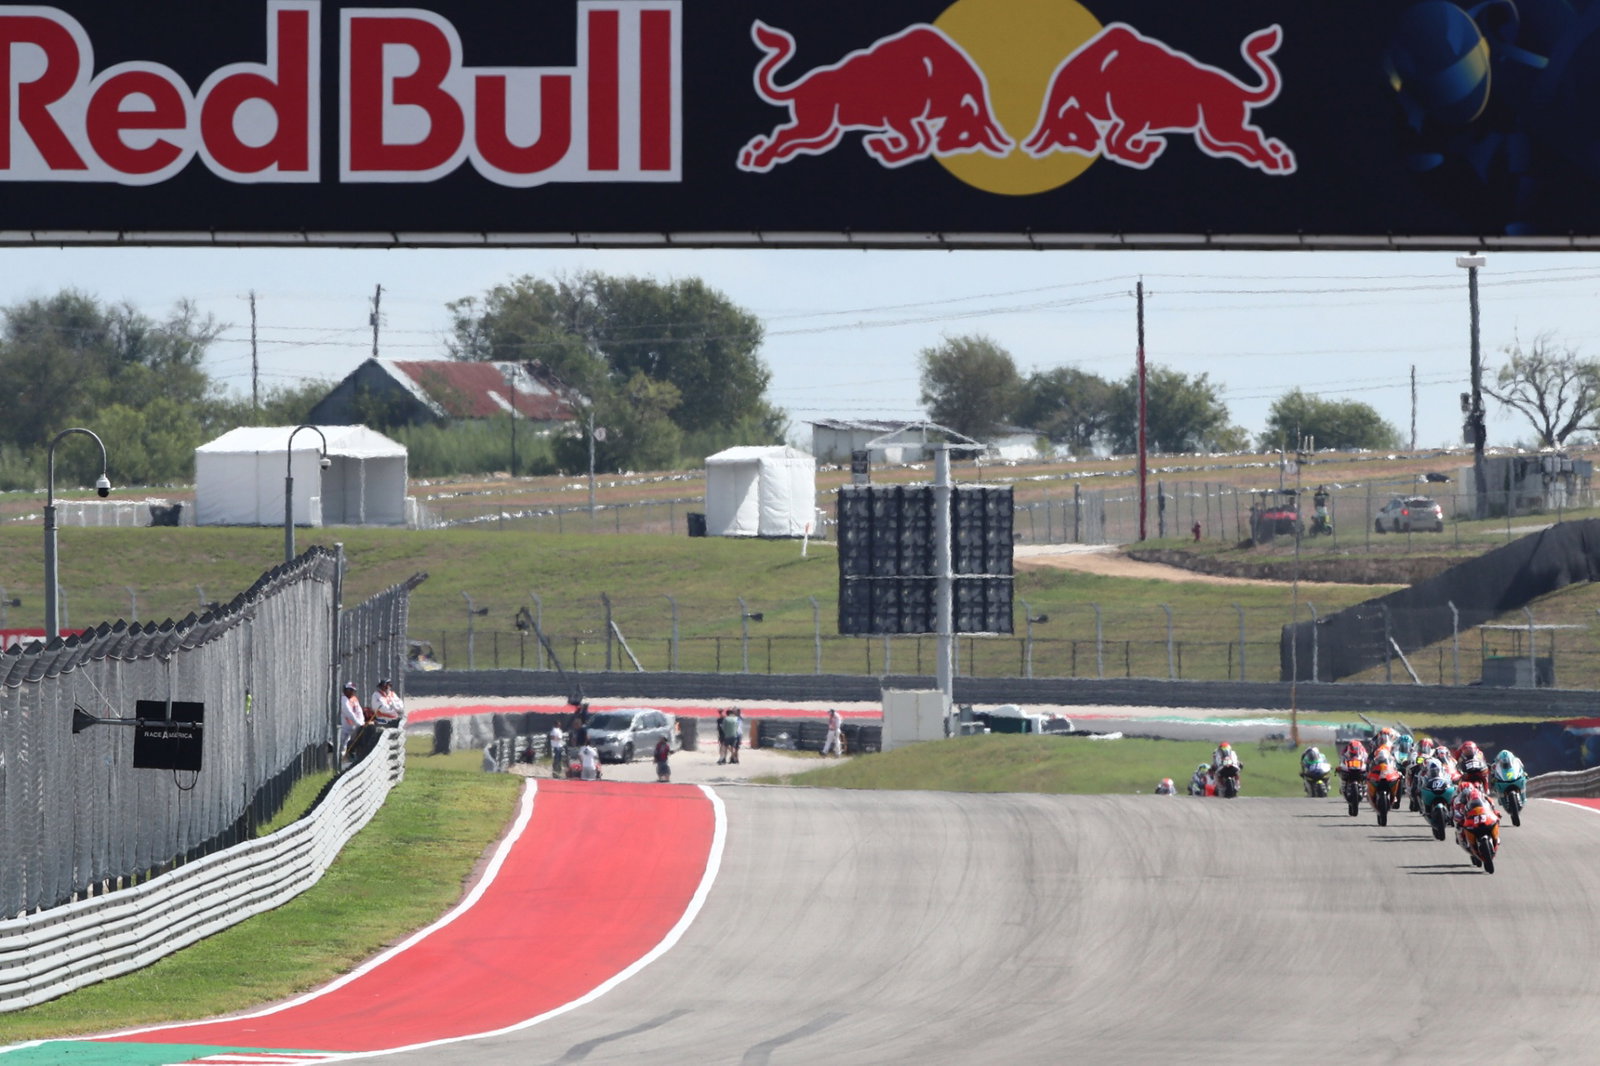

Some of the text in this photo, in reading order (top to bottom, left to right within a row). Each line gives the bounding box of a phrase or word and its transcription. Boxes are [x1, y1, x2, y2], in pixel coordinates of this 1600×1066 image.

[0, 2, 680, 184] Red Bull
[1473, 814, 1487, 824] 53
